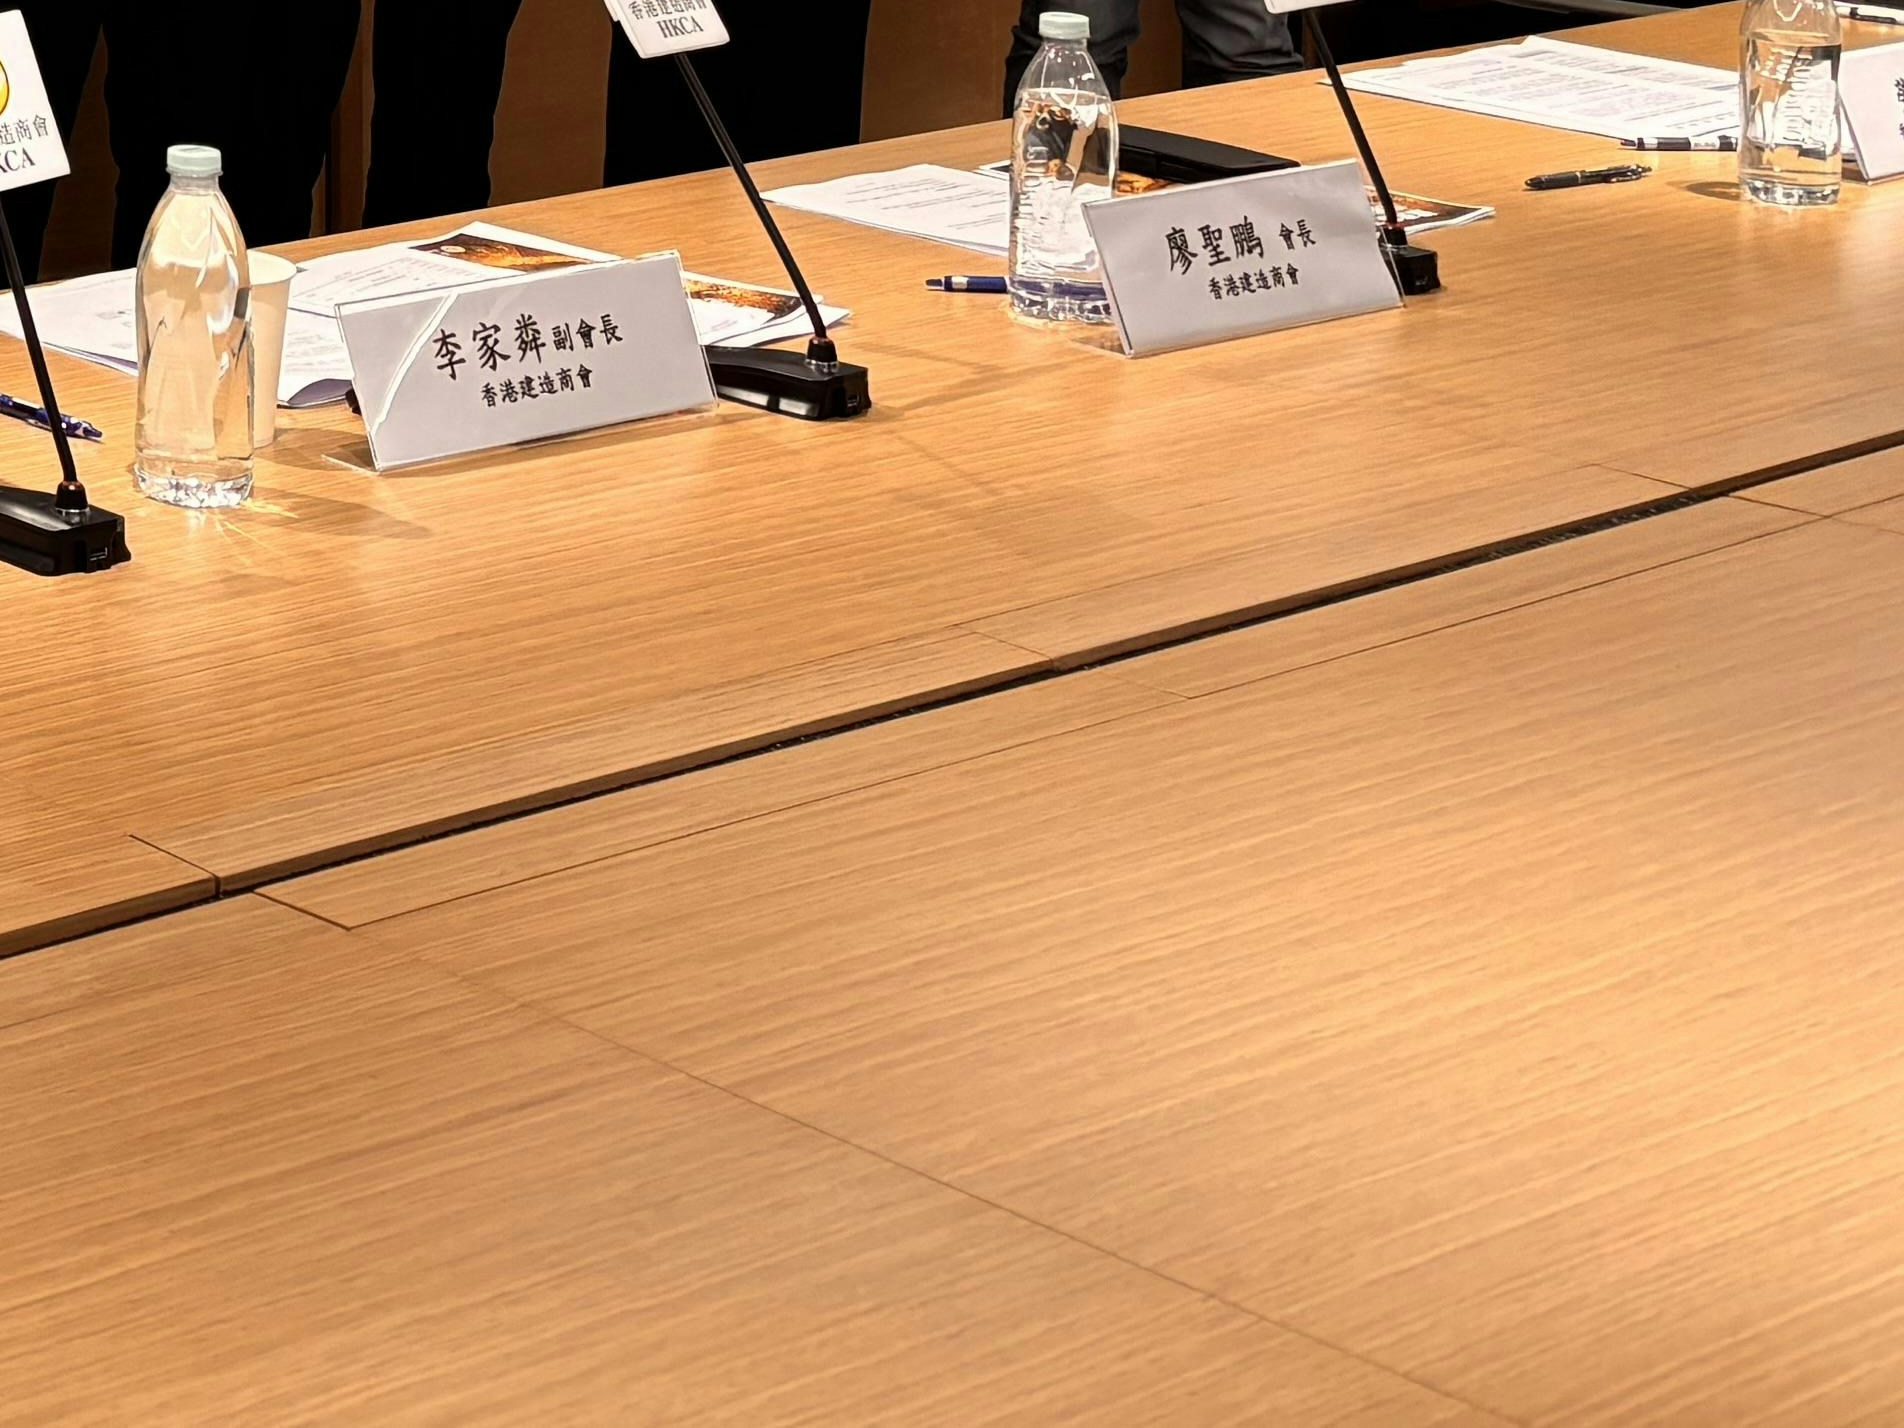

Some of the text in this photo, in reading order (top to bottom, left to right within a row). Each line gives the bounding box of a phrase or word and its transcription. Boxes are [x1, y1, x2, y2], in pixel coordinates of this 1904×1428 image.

[655, 16, 704, 39] HKCA
[1165, 215, 1317, 275] 廖聖鵬 會長
[1208, 263, 1299, 300] 香港建造商會
[551, 313, 624, 352] 副會長
[481, 363, 593, 408] 香港建造商會
